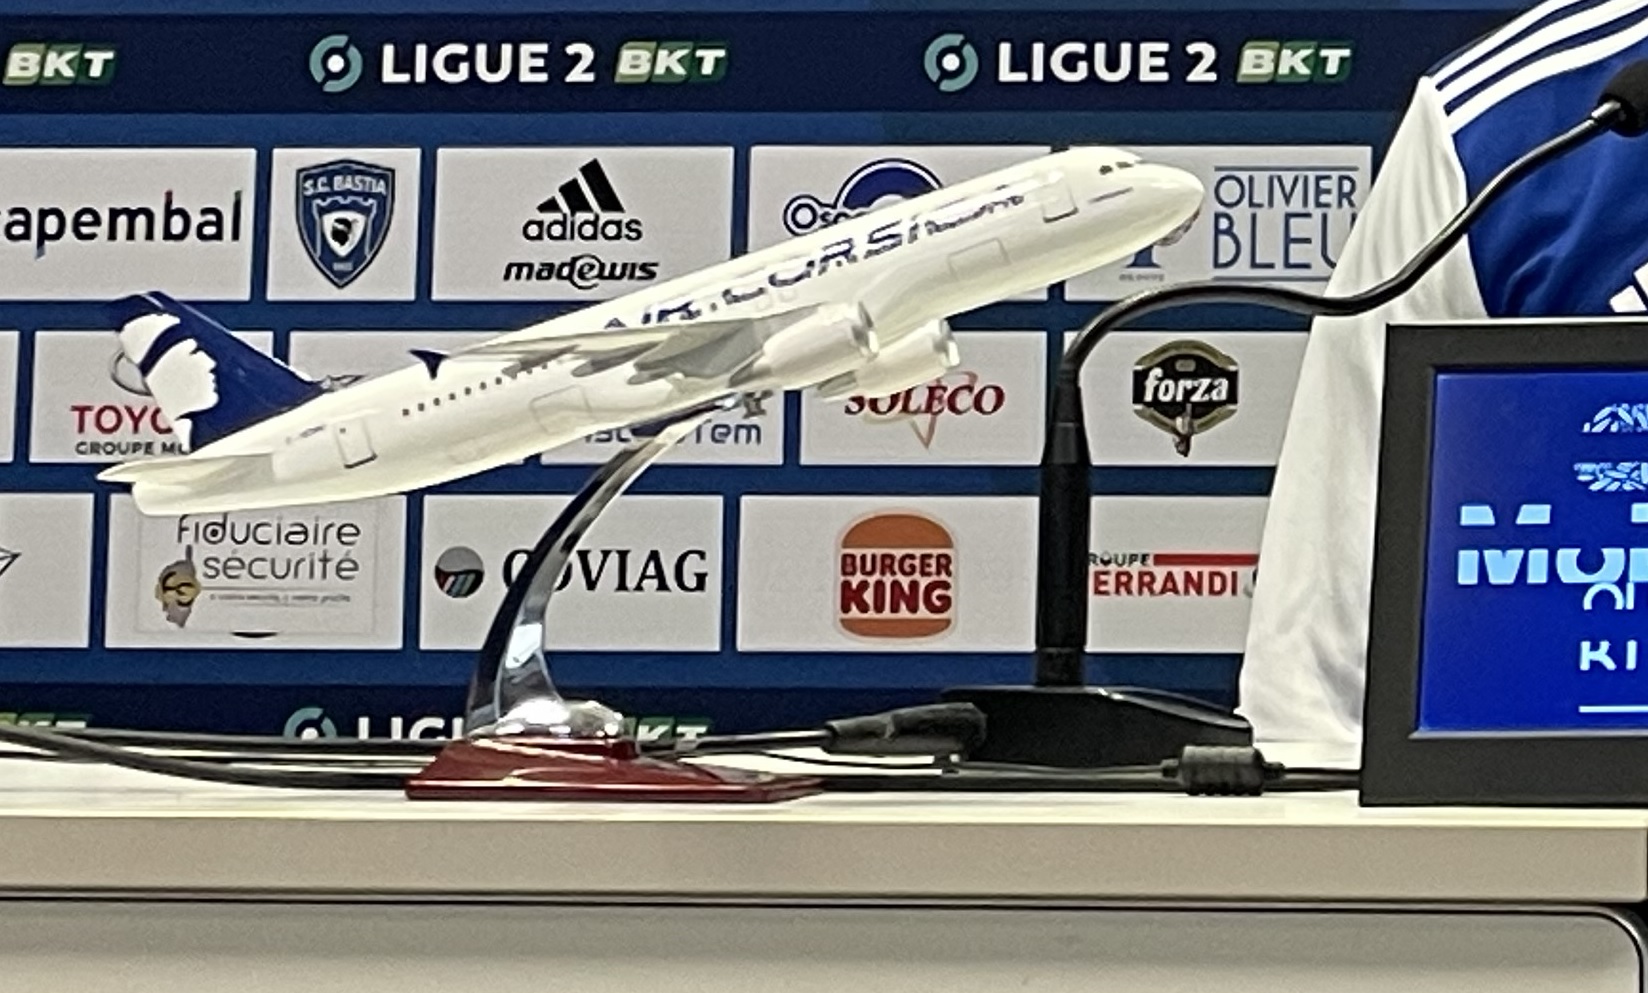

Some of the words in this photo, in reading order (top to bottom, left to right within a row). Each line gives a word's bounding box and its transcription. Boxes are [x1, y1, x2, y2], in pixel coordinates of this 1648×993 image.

[381, 44, 548, 83] LIGUE
[564, 43, 595, 83] 2
[616, 50, 726, 75] BKT
[999, 41, 1169, 83] LIGUE
[1185, 41, 1218, 83] 2
[1240, 48, 1351, 75] BKT
[334, 175, 387, 196] BASTIA
[1214, 174, 1355, 208] OLIVIER
[522, 210, 642, 241] adidas
[1143, 366, 1230, 403] forza
[75, 442, 166, 456] GROUPE
[177, 512, 360, 546] fiduciaire
[841, 553, 953, 577] BURGER
[840, 579, 952, 615] KING
[1093, 571, 1238, 596] ERRANDI
